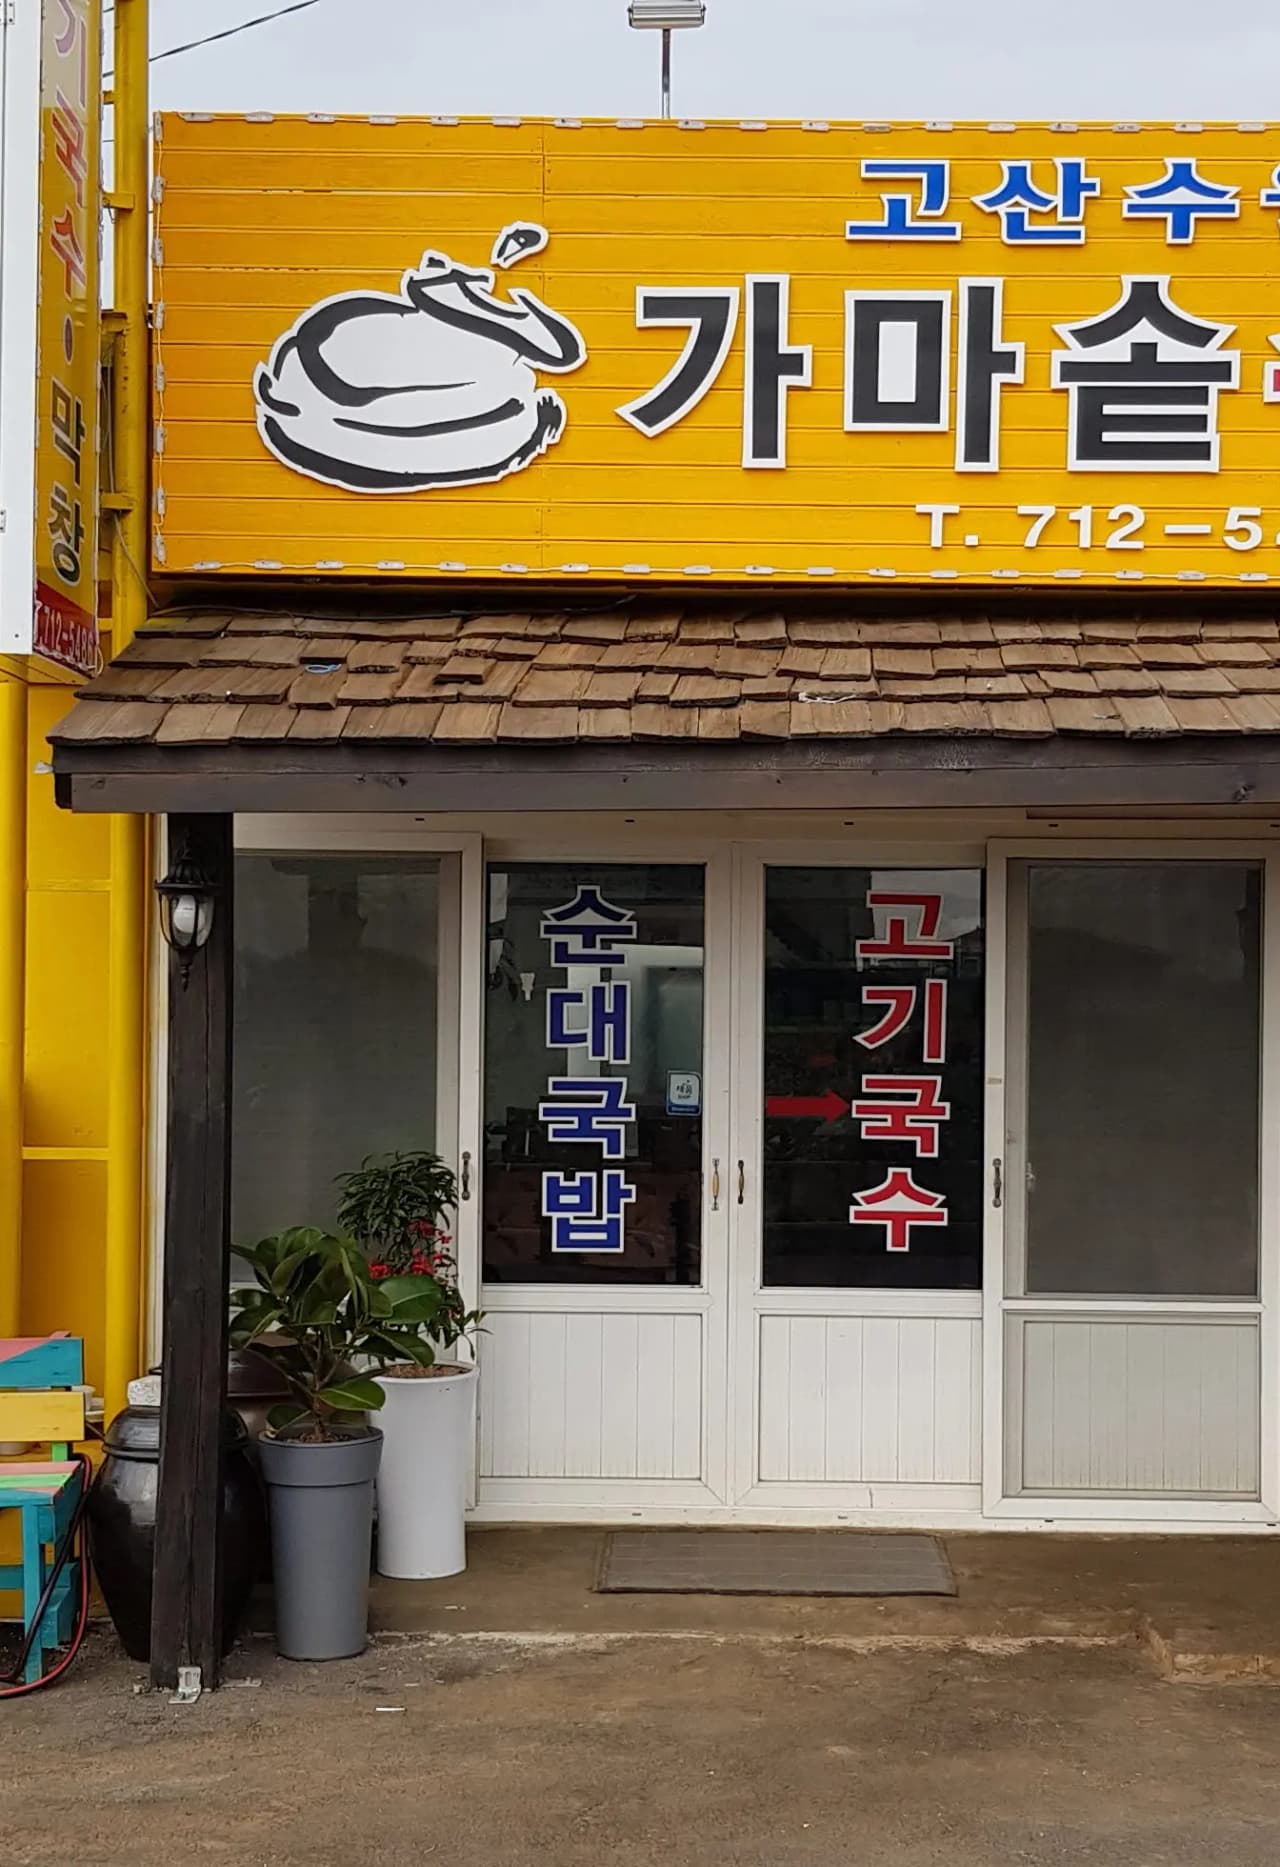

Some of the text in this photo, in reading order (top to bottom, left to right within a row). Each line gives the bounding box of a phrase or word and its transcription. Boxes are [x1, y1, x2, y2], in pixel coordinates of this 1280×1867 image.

[48, 376, 86, 586] 막창
[539, 885, 637, 1252] 순대국밥
[849, 889, 955, 1252] 고기국수
